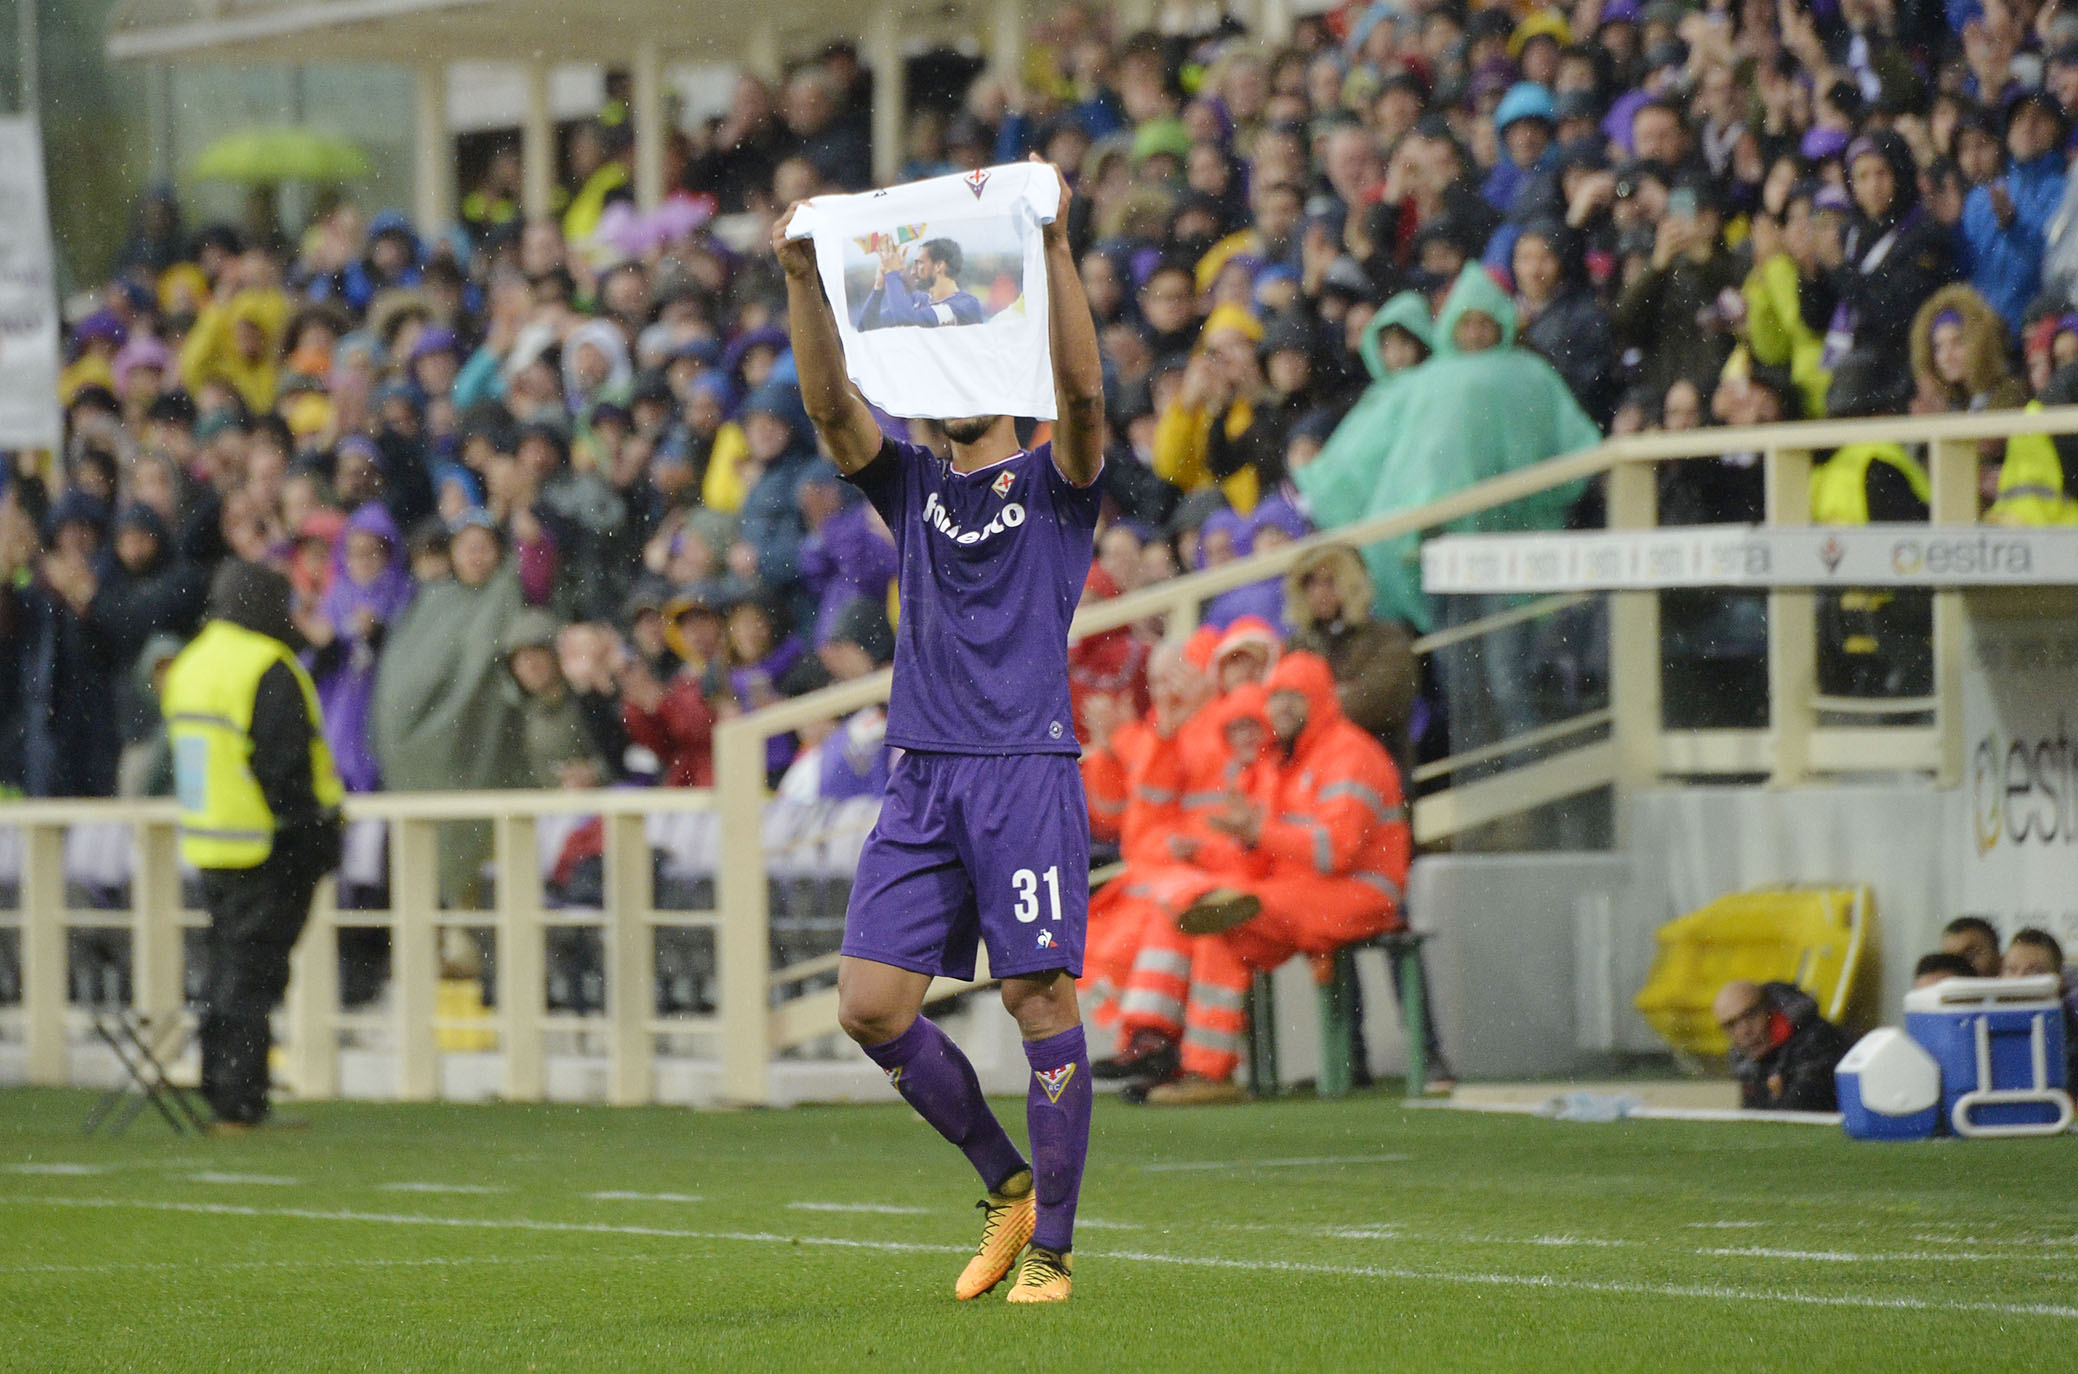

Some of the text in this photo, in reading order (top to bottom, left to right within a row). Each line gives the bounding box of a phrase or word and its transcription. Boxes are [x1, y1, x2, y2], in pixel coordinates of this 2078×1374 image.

[1926, 533, 2032, 573] estra
[2005, 714, 2078, 845] est
[1012, 866, 1062, 923] 31
